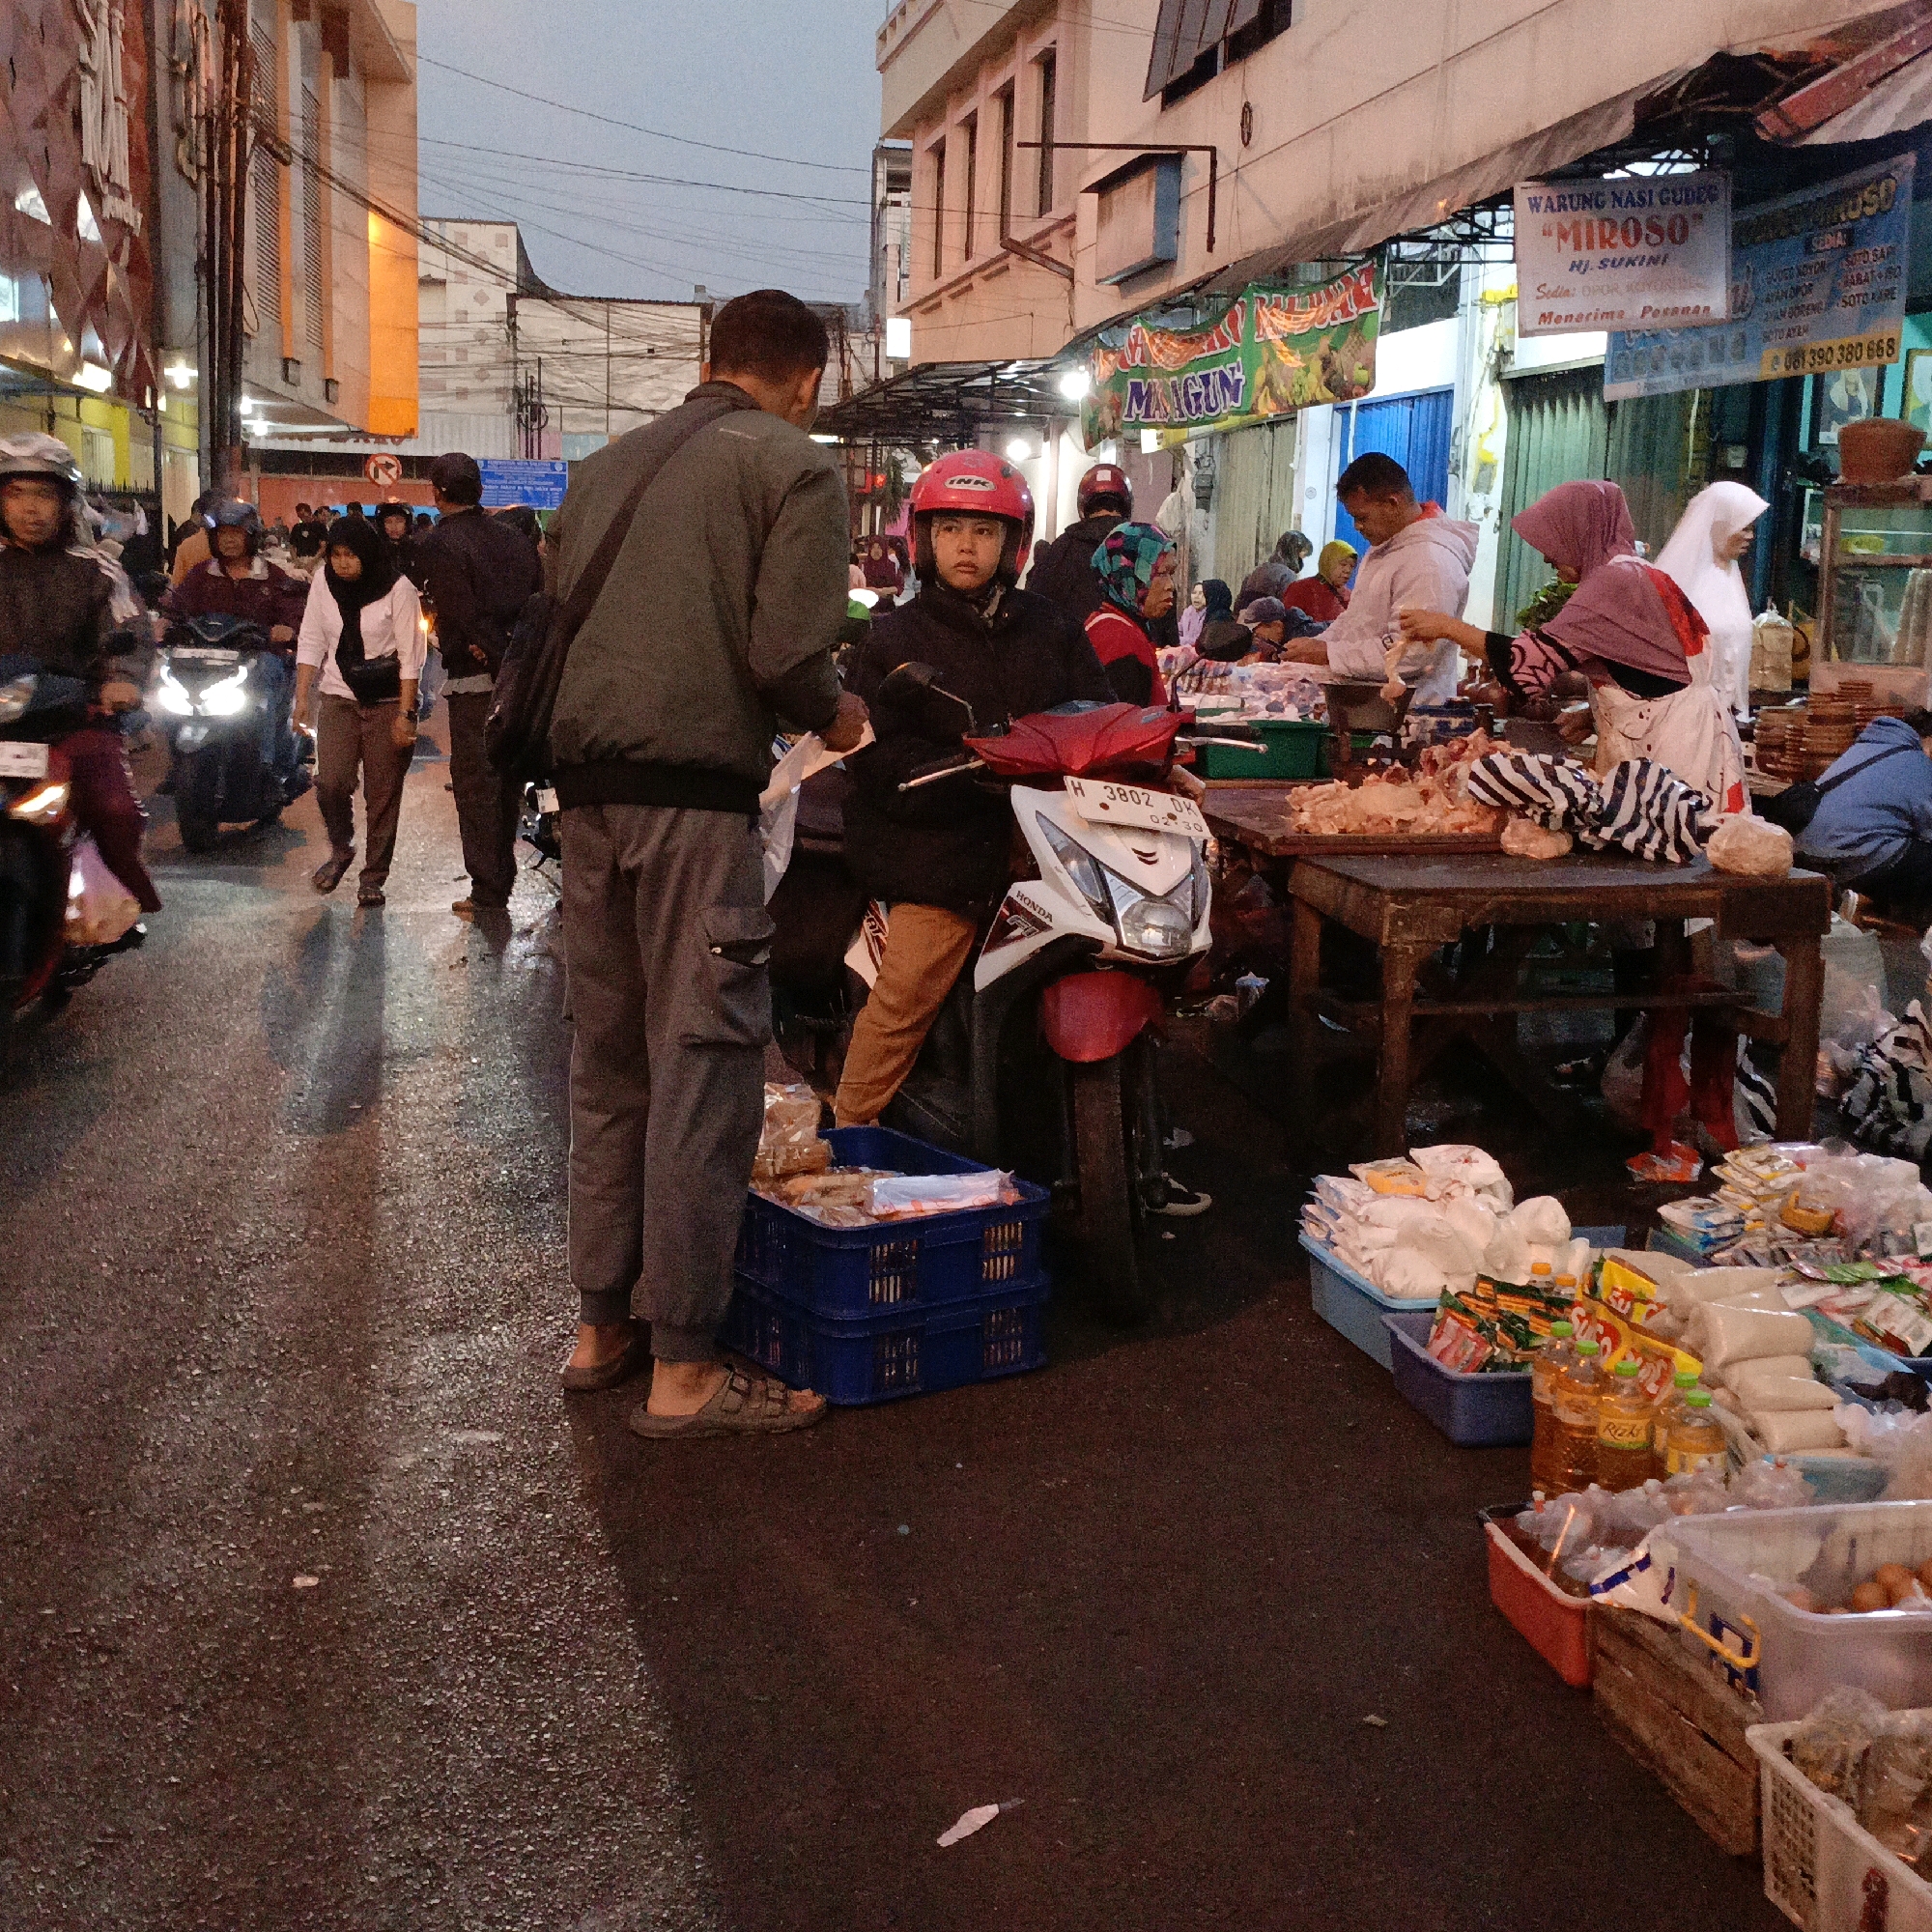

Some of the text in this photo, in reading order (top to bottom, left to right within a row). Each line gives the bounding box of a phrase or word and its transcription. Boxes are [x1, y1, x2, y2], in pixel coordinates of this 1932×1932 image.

[1527, 193, 1607, 214] WARUNG
[1611, 188, 1654, 210] NASI
[1598, 253, 1670, 270] SUKINI
[1538, 307, 1626, 326] Menerima
[948, 477, 991, 489] INK
[1070, 780, 1086, 798] H
[1103, 785, 1154, 809] 3802
[1015, 890, 1054, 923] HONDA
